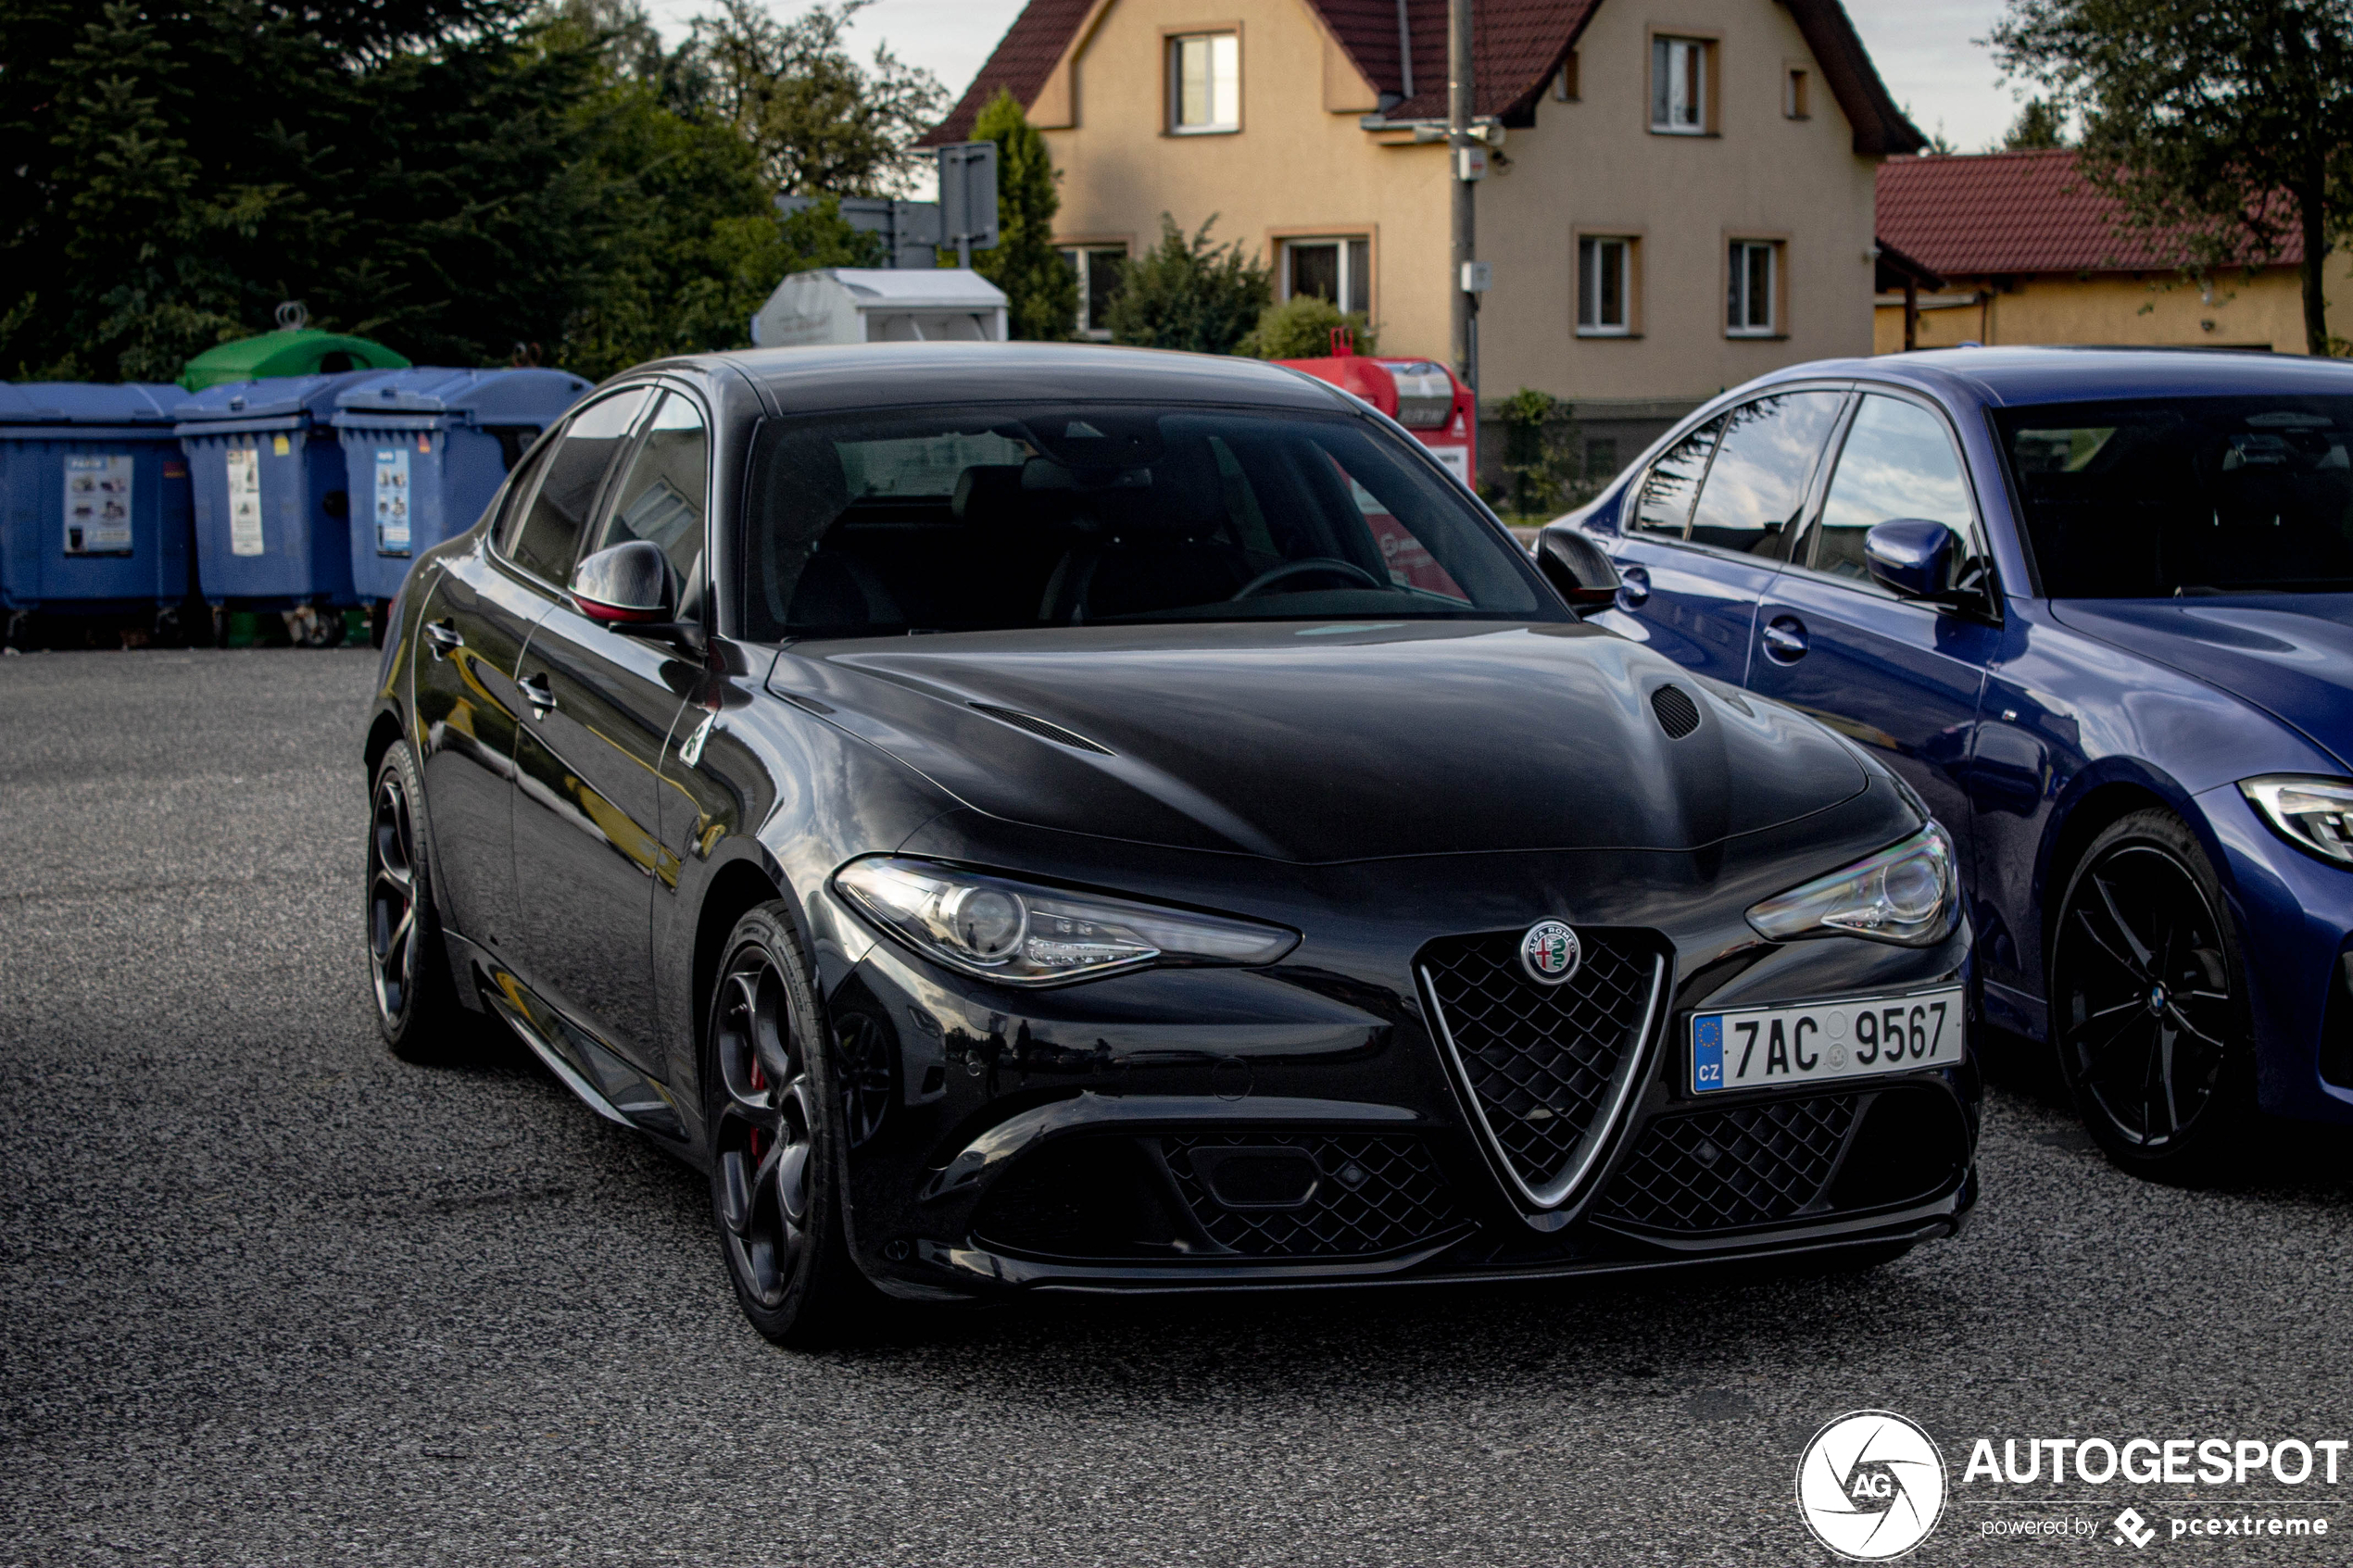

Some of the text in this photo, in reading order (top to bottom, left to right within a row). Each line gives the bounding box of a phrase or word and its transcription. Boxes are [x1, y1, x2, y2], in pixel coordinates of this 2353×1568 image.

[1529, 928, 1576, 953] ALFA ROMEO
[1735, 1001, 1947, 1079] 7AC 9567
[1699, 1063, 1720, 1082] CZ
